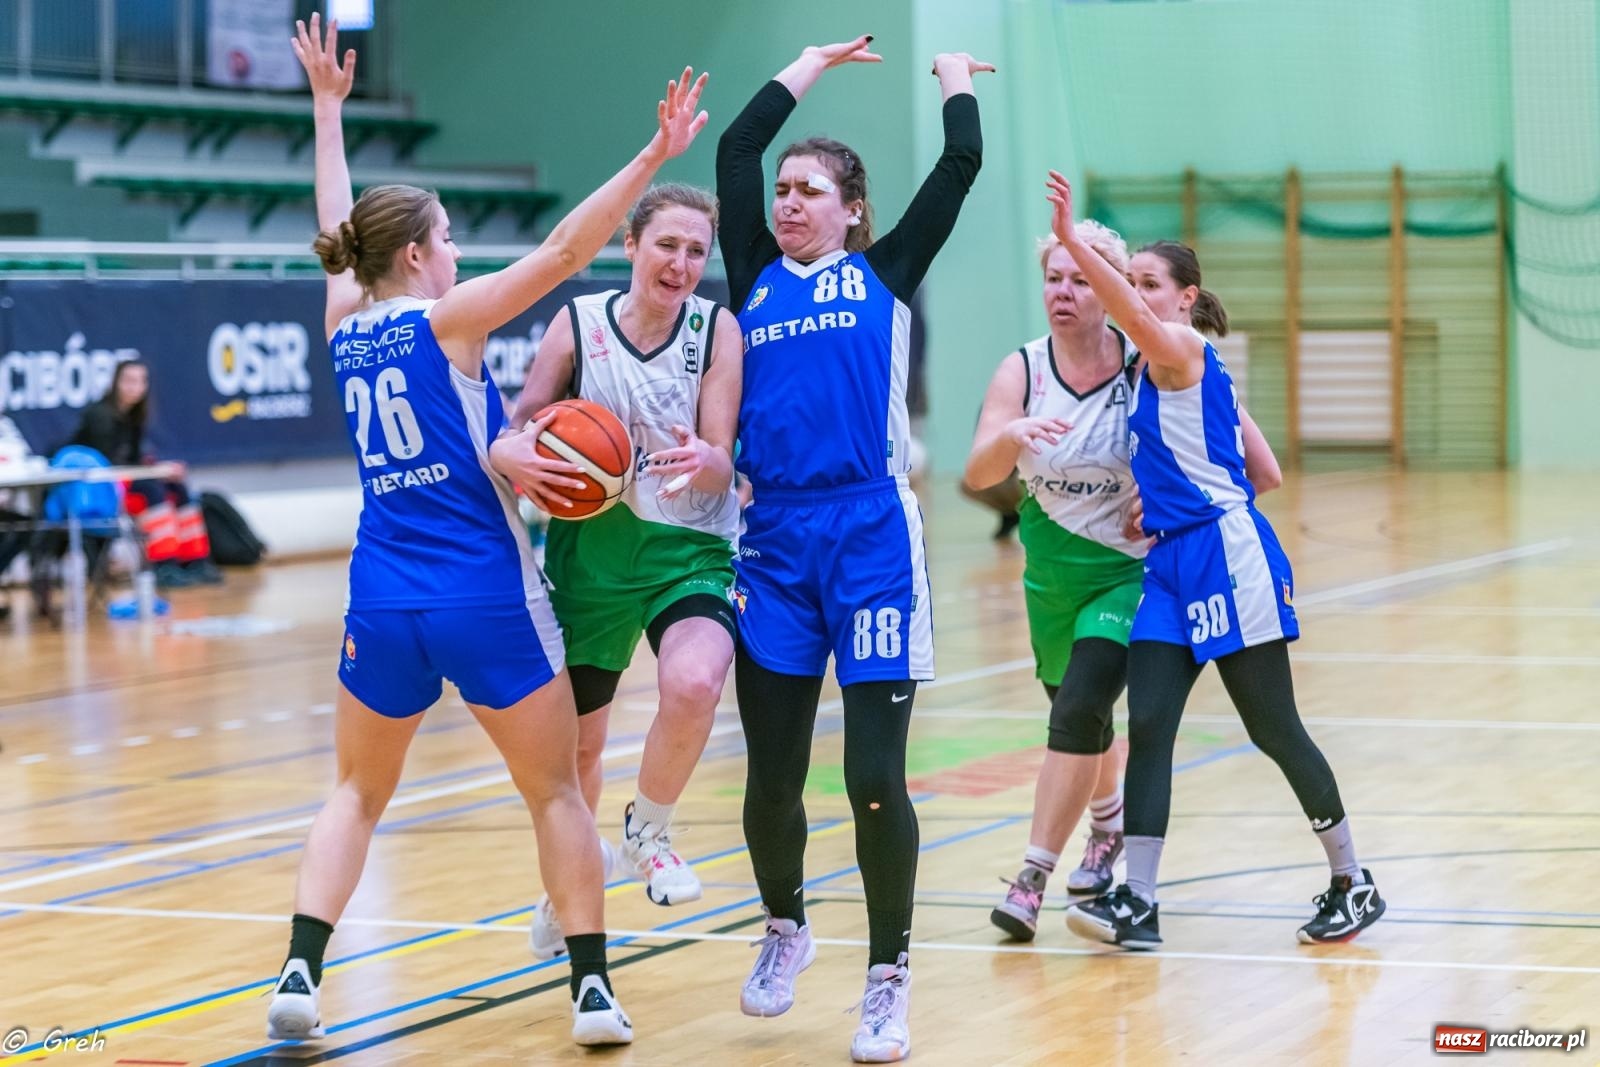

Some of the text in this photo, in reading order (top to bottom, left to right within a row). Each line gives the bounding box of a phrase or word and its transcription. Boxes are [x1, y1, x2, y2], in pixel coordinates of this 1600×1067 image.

[812, 264, 867, 304] 88
[750, 310, 858, 348] BETARD
[345, 366, 424, 469] 26
[371, 462, 450, 496] BETARD
[853, 606, 902, 661] 88
[1186, 594, 1230, 645] 30
